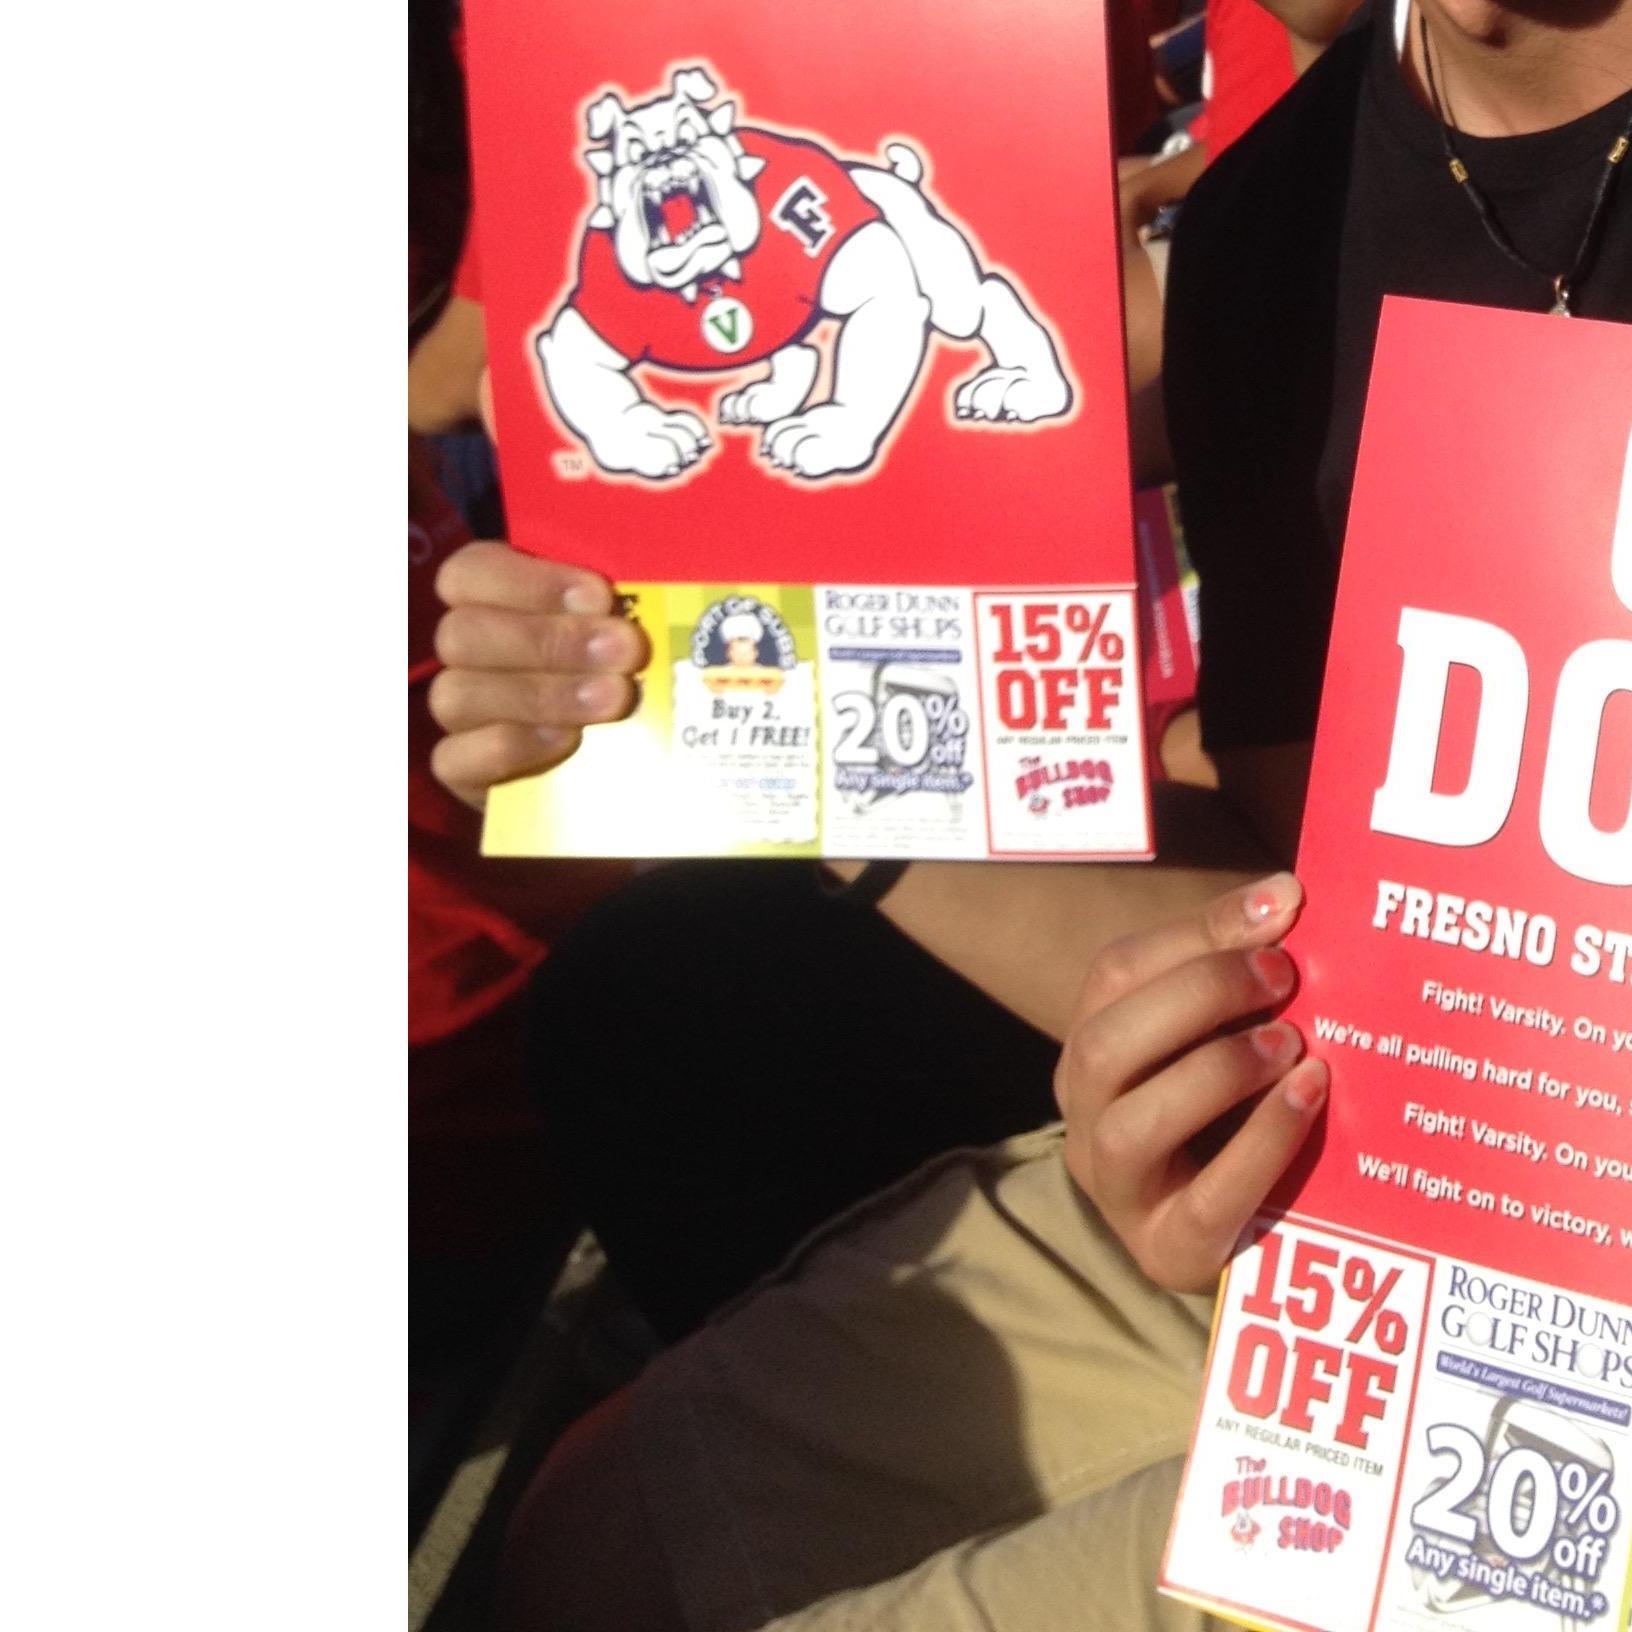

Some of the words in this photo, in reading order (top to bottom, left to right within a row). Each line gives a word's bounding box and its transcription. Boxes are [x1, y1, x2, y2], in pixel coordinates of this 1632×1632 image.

[776, 180, 831, 255] F
[708, 307, 741, 346] V
[989, 603, 1125, 663] 15%
[712, 698, 753, 725] Buy
[831, 690, 969, 766] 20%
[994, 668, 1123, 731] OFF
[682, 726, 719, 748] Get
[749, 725, 811, 747] FREE!
[930, 739, 966, 766] off
[1371, 880, 1559, 966] FRESNO
[1422, 979, 1484, 1016] Fight!
[1573, 1016, 1606, 1044] On
[1314, 1016, 1374, 1051] We're
[1376, 1035, 1403, 1058] all
[1405, 1043, 1478, 1081] pulling
[1482, 1058, 1534, 1092] hard
[1537, 1071, 1571, 1100] for
[1575, 1085, 1622, 1117] you,
[1403, 1100, 1465, 1140] Fight!
[1554, 1141, 1588, 1170] On
[1357, 1152, 1409, 1187] We'll
[1413, 1169, 1463, 1203] fight
[1466, 1188, 1496, 1212] on
[1500, 1194, 1525, 1219] to
[1530, 1202, 1612, 1245] victory,
[1241, 1229, 1408, 1356] 15%
[1448, 1264, 1543, 1322] ROGER
[1226, 1322, 1399, 1451] OFF
[1440, 1352, 1480, 1378] World's
[1480, 1366, 1522, 1392] Largest
[1521, 1377, 1551, 1400] Golf
[1216, 1417, 1240, 1433] ANY
[1245, 1424, 1301, 1452] REGULAR
[1304, 1441, 1351, 1467] PRICED
[1353, 1456, 1384, 1477] ITEM
[1221, 1475, 1352, 1532] BULLDOG
[1410, 1423, 1619, 1560] 20%
[1277, 1515, 1344, 1554] SHOP
[1553, 1536, 1606, 1577] off
[1408, 1536, 1456, 1579] Any
[1457, 1557, 1527, 1595] single
